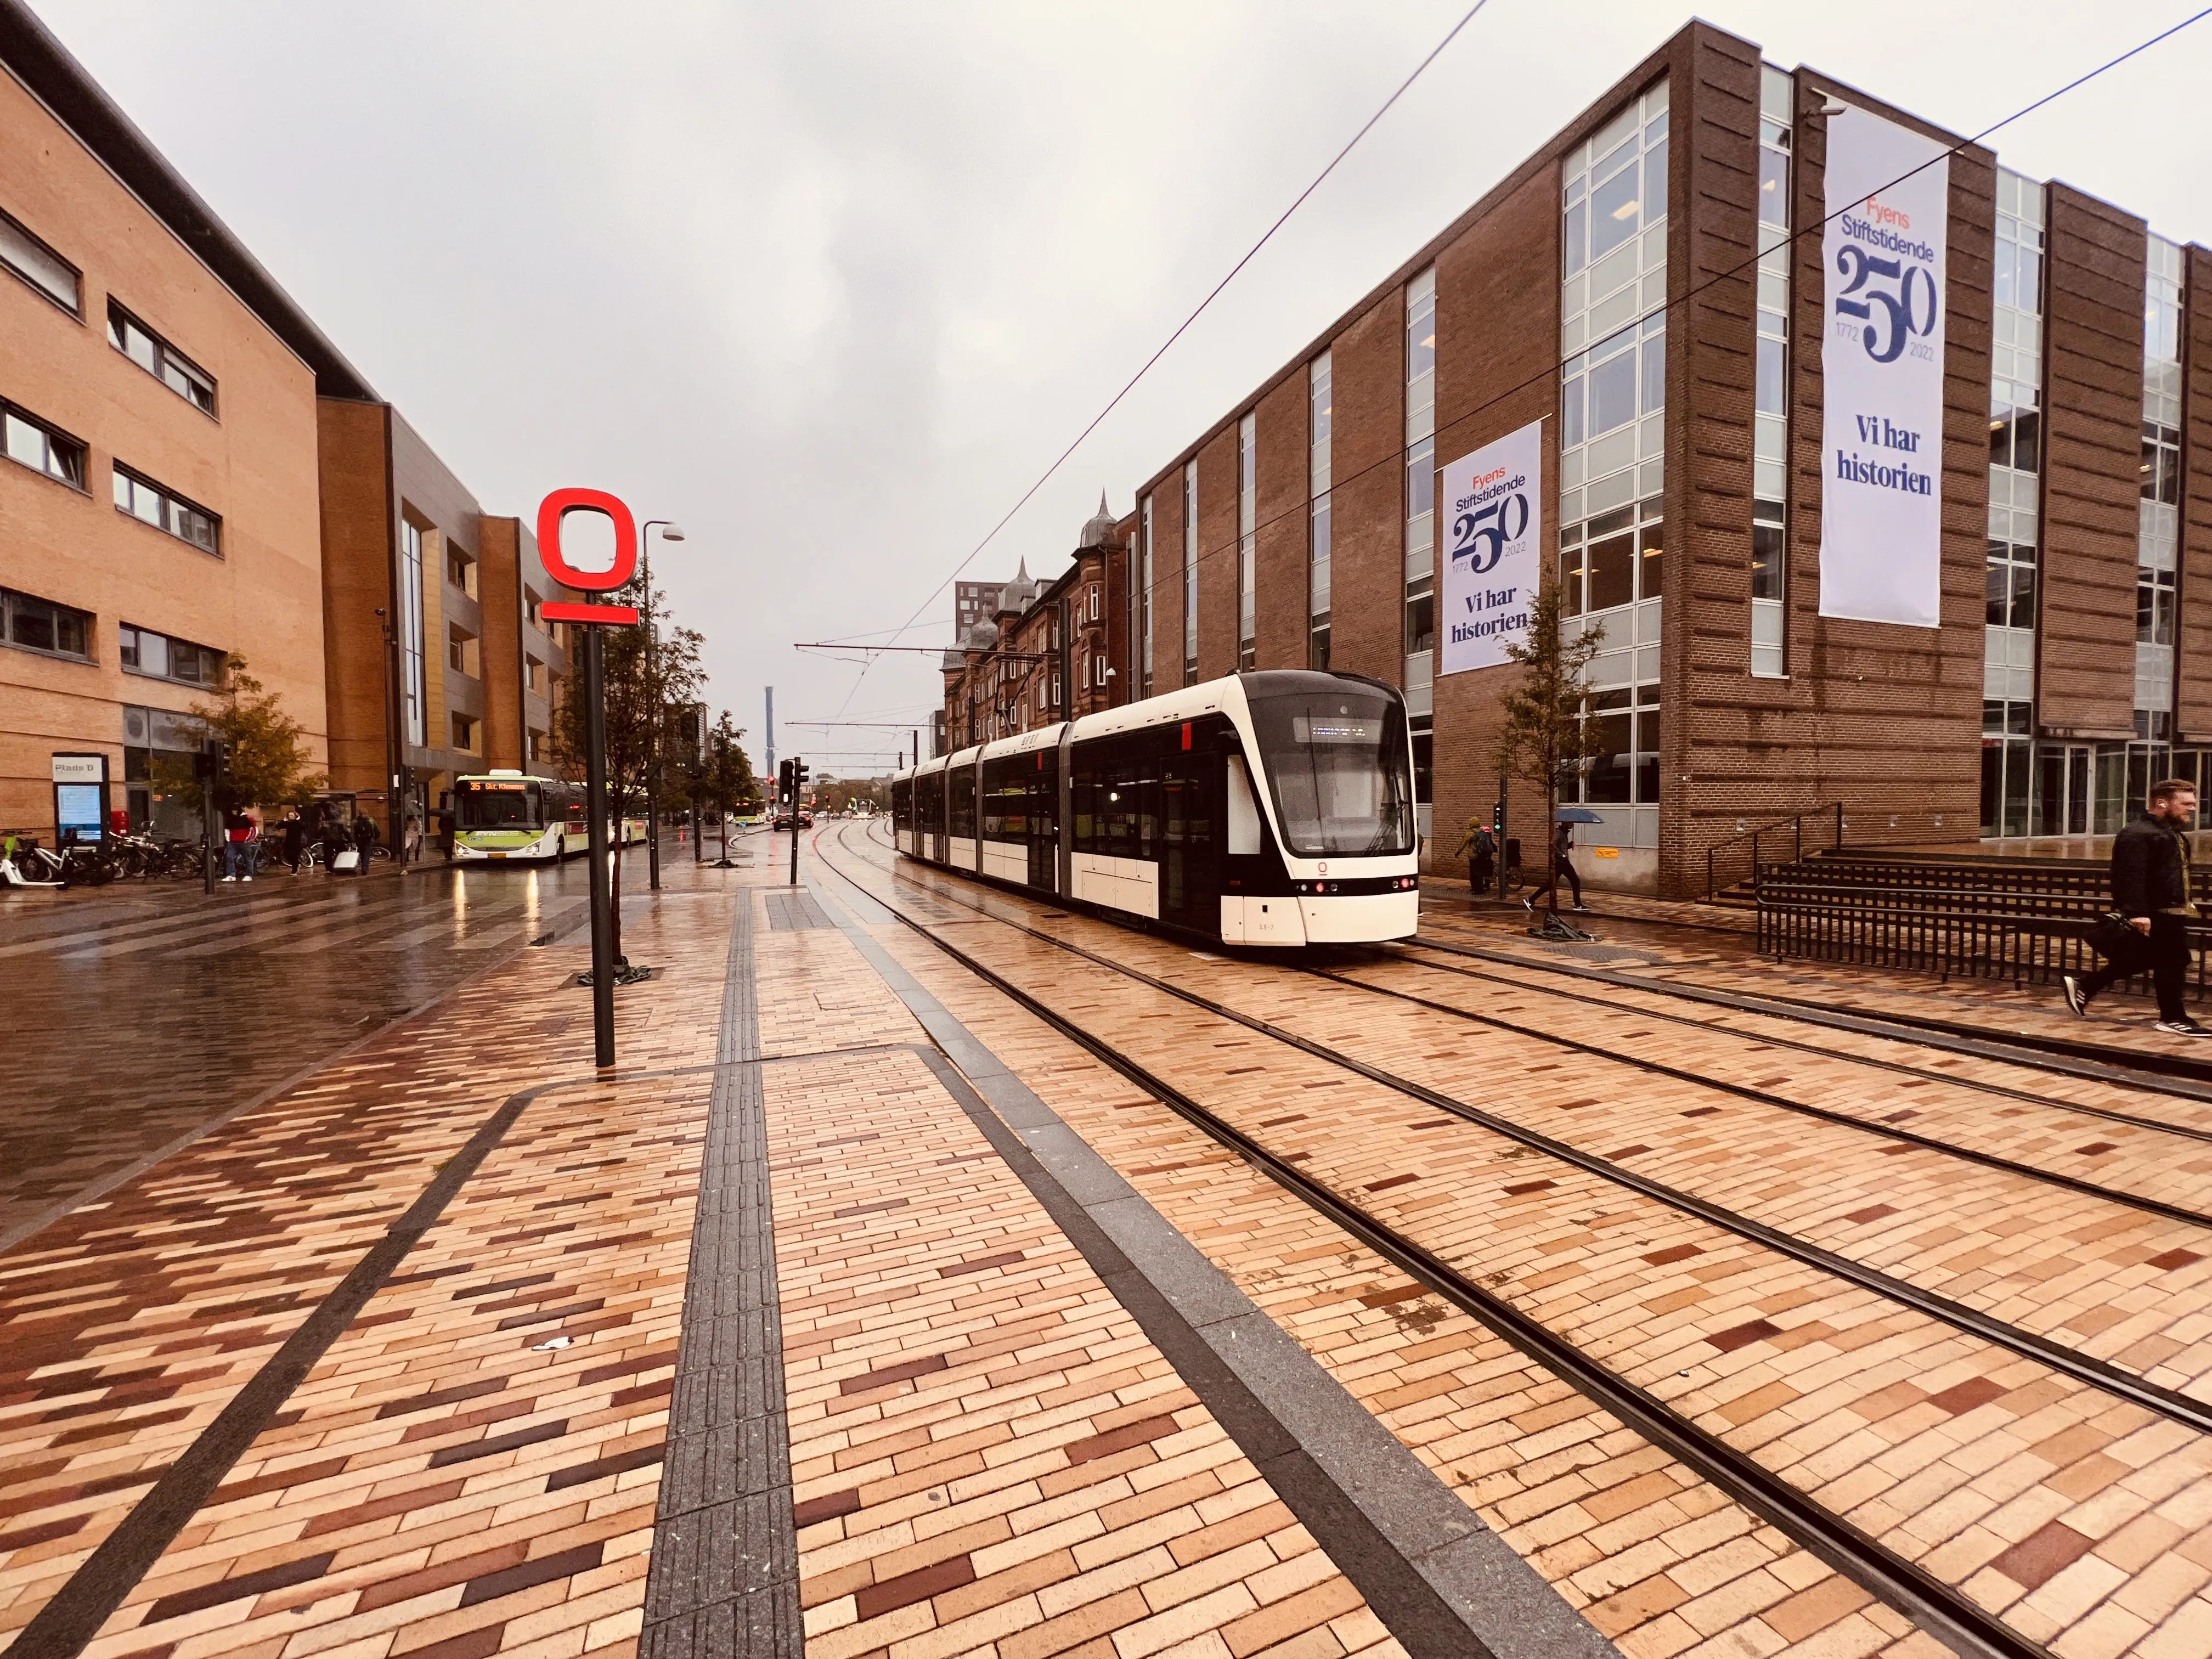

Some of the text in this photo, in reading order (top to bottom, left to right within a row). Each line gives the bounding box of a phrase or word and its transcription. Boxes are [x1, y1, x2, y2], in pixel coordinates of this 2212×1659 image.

[1866, 196, 1910, 229] Fyens
[1841, 213, 1934, 263] Stiftstidende
[1836, 244, 1937, 363] 250
[1836, 321, 1934, 362] 1772 2022
[1855, 414, 1921, 453] Vi har
[1472, 467, 1506, 490] Fyens
[1837, 449, 1932, 496] historien
[1455, 475, 1526, 513] Stiftstidende
[1452, 493, 1529, 574] 250
[1504, 541, 1527, 557] 2022
[1452, 561, 1469, 574] 1772
[1465, 588, 1517, 614] Vi har
[1451, 613, 1528, 644] historien
[470, 782, 481, 791] 35
